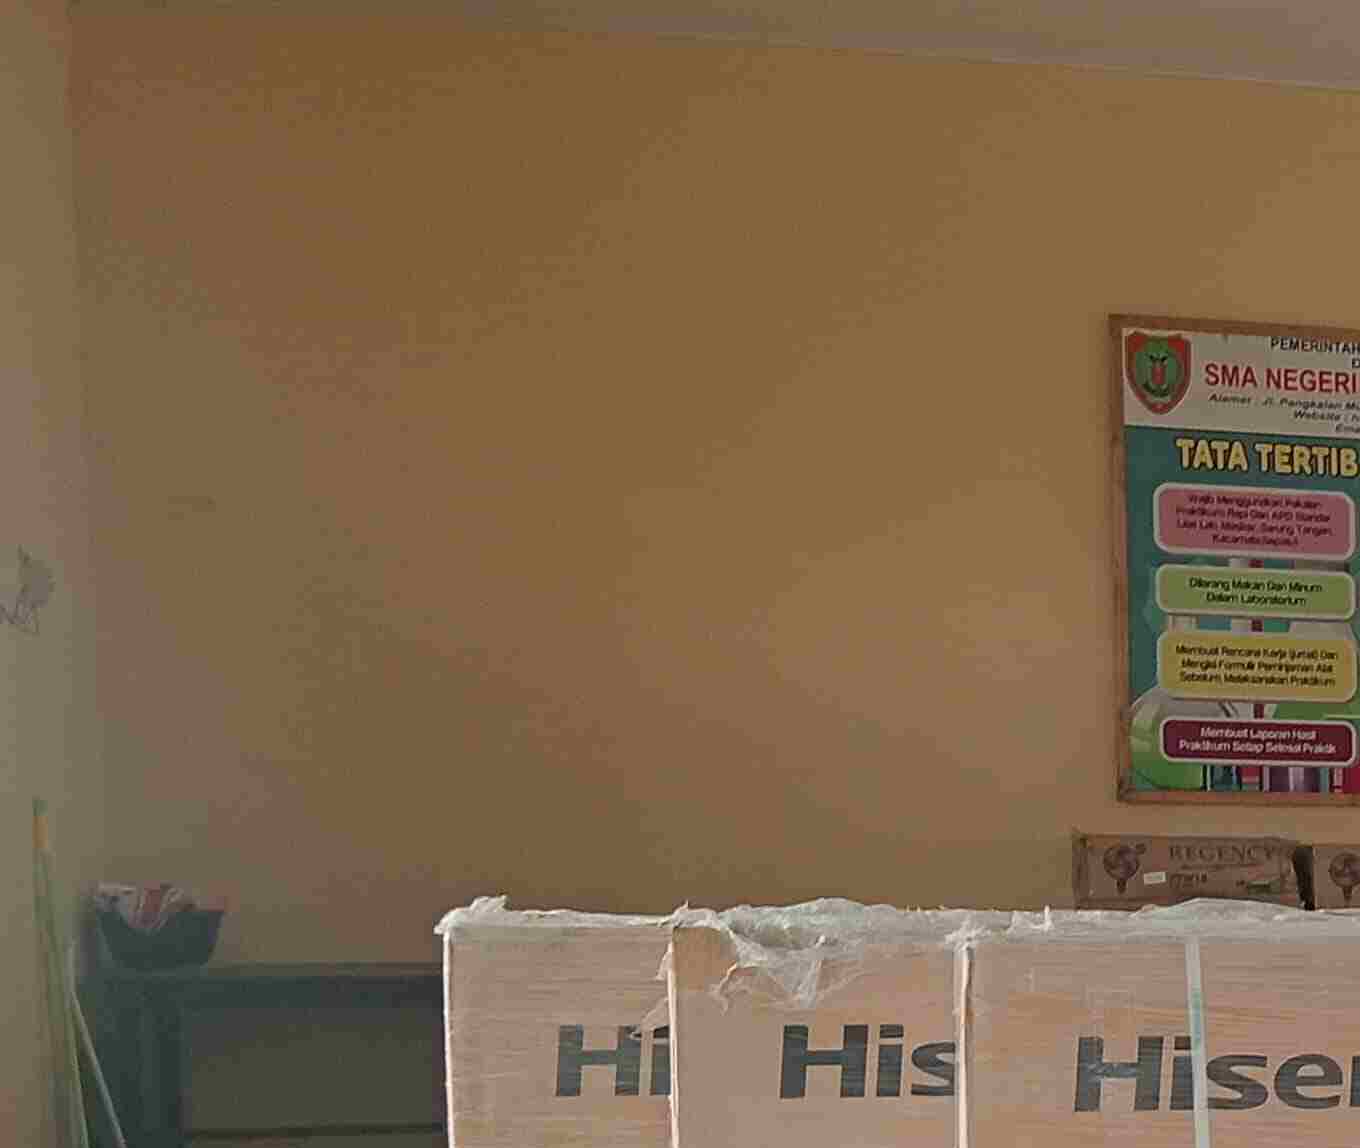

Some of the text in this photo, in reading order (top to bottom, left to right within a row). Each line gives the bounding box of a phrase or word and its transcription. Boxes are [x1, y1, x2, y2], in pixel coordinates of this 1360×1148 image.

[1270, 336, 1360, 356] PEMERINTAH
[1204, 363, 1257, 388] SMA
[1266, 368, 1357, 394] NEGERI
[1175, 437, 1250, 473] TATA
[1254, 442, 1360, 479] TERTIB
[1189, 576, 1323, 592] Dilarang Makan Dan Minum
[1206, 592, 1307, 606] Dalam Laboratorium
[1200, 727, 1248, 738] Membuat
[1250, 728, 1291, 742] Laporan
[1168, 845, 1277, 863] REGENCY
